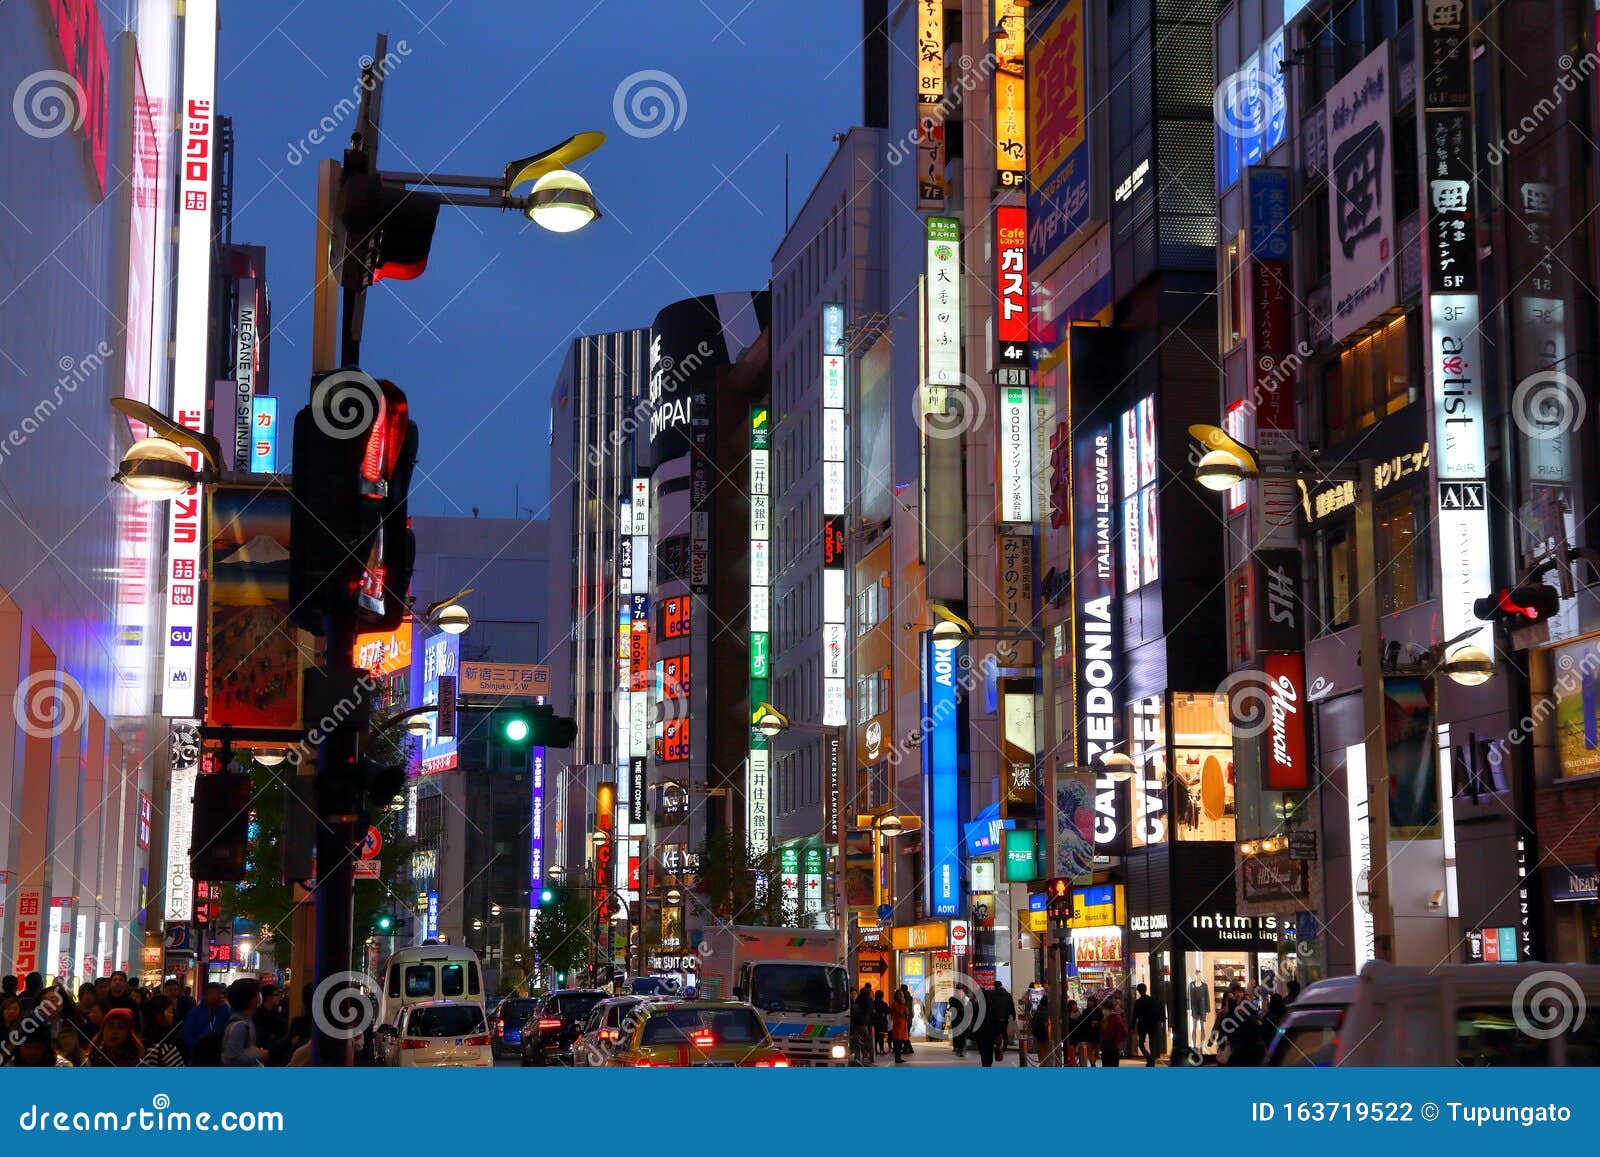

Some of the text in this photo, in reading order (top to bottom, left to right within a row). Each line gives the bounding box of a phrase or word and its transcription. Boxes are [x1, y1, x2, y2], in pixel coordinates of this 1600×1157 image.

[922, 77, 940, 88] 8F
[186, 99, 209, 181] ビックロ
[1002, 172, 1023, 185] 9F
[924, 187, 940, 197] 7F
[1000, 227, 1024, 239] Café
[1001, 248, 1024, 320] ガスト
[1444, 276, 1464, 287] 5F
[1444, 307, 1464, 320] 3F
[240, 309, 252, 360] MEGANE
[1004, 345, 1023, 359] 4F
[238, 374, 250, 403] TOP
[1447, 464, 1475, 473] HAIR
[754, 458, 766, 531] 三井住友銀行
[635, 498, 645, 521] 献血
[1096, 436, 1110, 578] ITALIAN LEGWEAR
[825, 520, 834, 563] union
[635, 611, 645, 619] 7F
[172, 631, 191, 642] GU
[465, 666, 547, 683] 新宿三丁目西
[480, 681, 511, 691] Shinjuku
[522, 682, 529, 690] W
[636, 702, 644, 746] KEYUCA
[1270, 674, 1299, 768] Hawaii
[831, 740, 839, 786] UNIVERSAL
[753, 760, 766, 841] 三井住友銀行
[171, 864, 184, 919] ROLEX
[937, 904, 956, 914] AOKI
[1131, 915, 1168, 931] CALZEDONIA
[1219, 930, 1253, 940] Italian
[663, 957, 680, 968] SUIT
[682, 957, 696, 968] CO
